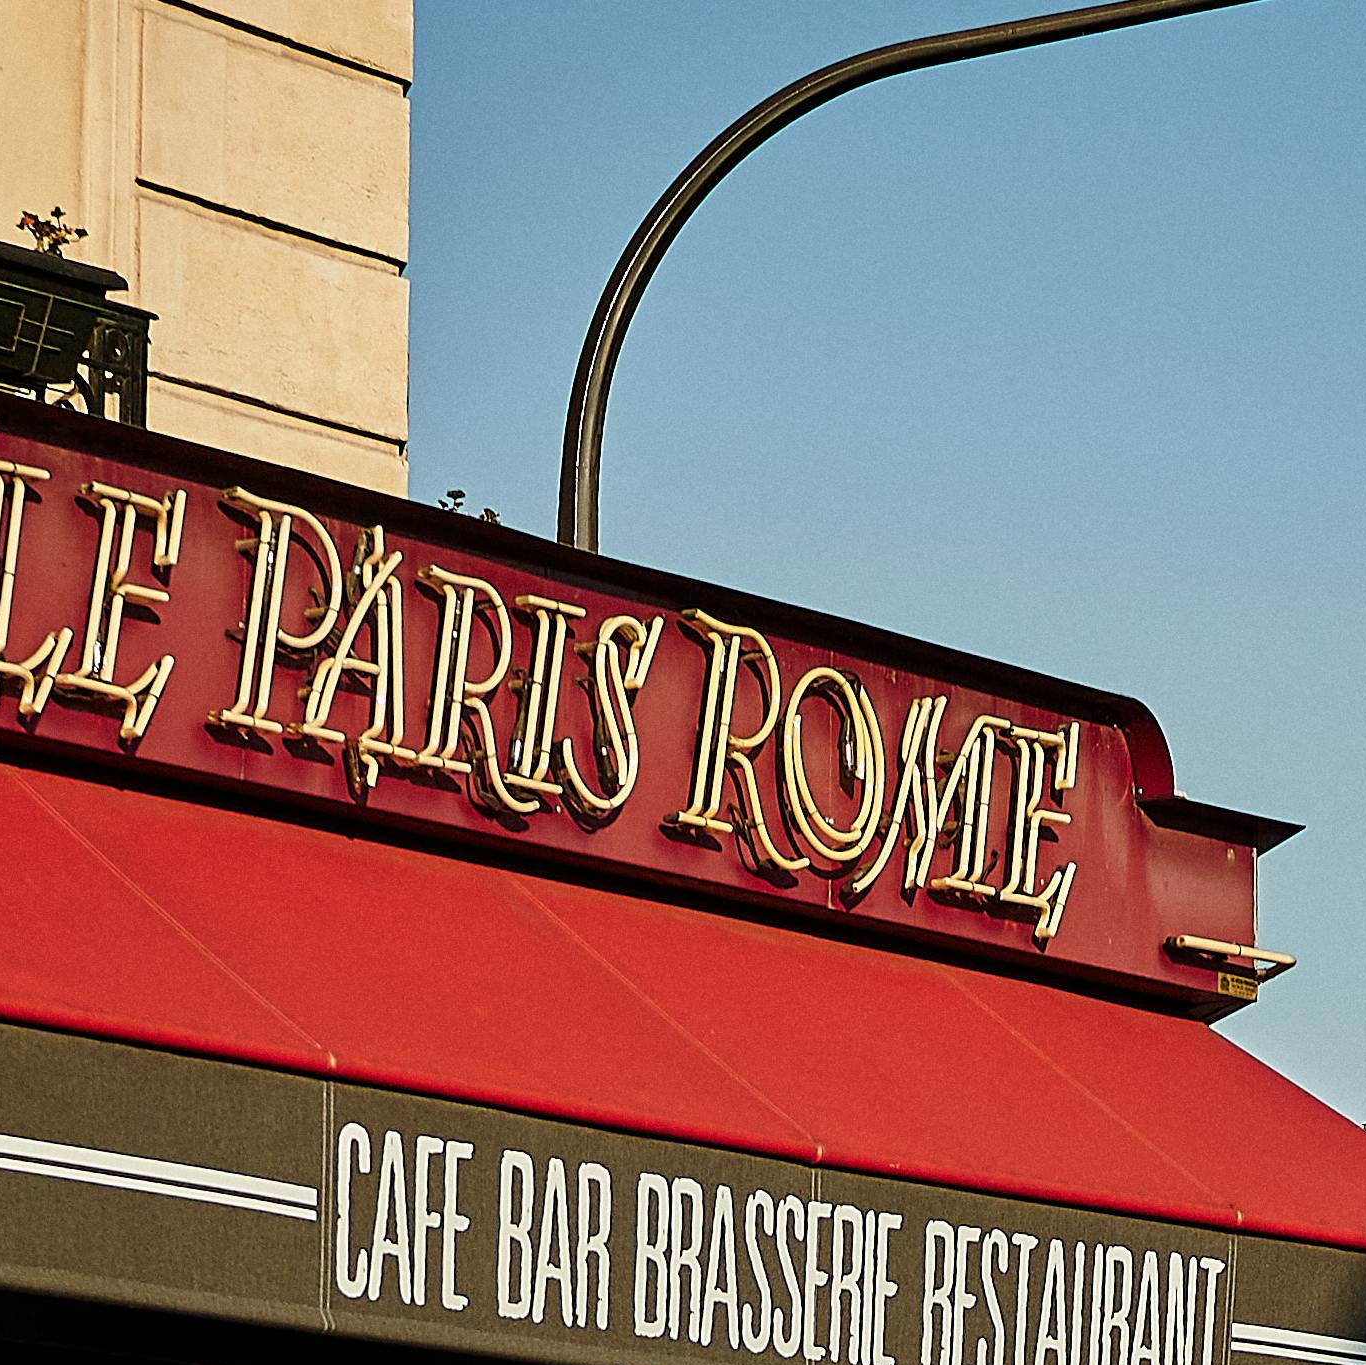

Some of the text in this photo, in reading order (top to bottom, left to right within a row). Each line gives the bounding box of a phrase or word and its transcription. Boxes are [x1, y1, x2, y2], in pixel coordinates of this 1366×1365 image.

[208, 487, 667, 815] PARIS
[675, 607, 1081, 941] ROME
[336, 1123, 473, 1312] CAFE
[498, 1148, 611, 1332] BAR
